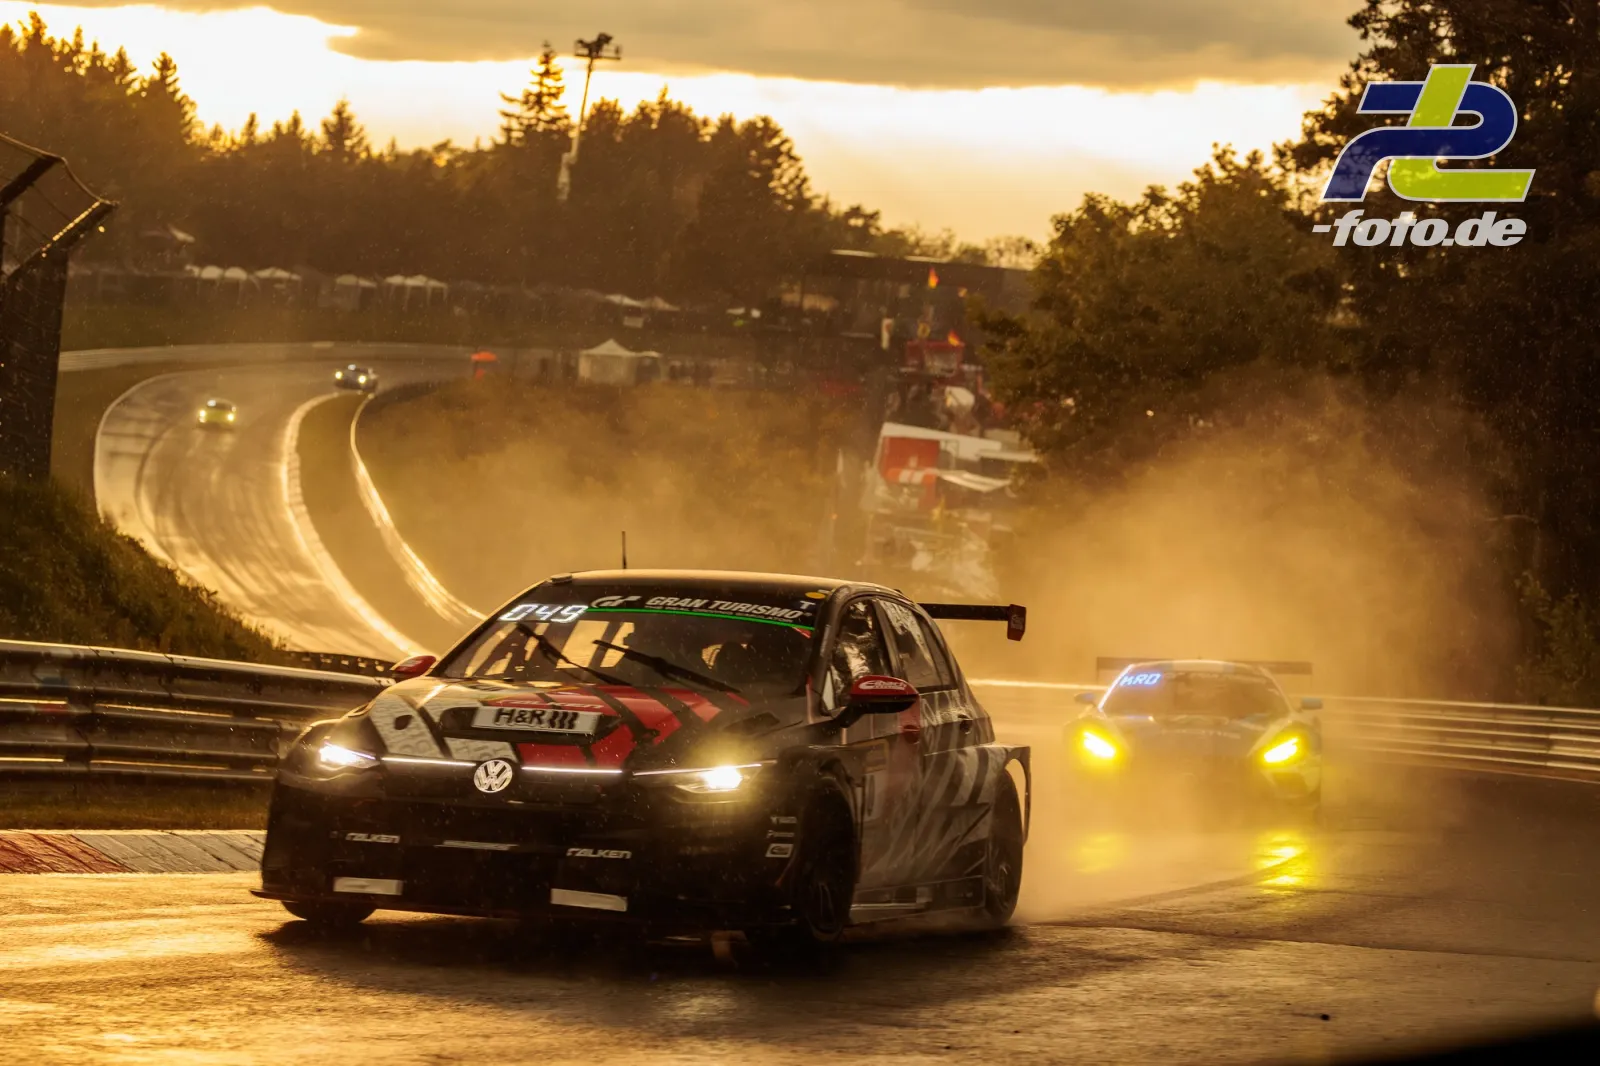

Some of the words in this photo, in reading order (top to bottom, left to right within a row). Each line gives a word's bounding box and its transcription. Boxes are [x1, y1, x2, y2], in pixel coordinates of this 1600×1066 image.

[646, 596, 709, 608] GRAN
[709, 600, 803, 619] TURISMO
[494, 708, 546, 725] H&R
[345, 832, 400, 843] FALKEN
[566, 847, 632, 859] FALKEN
